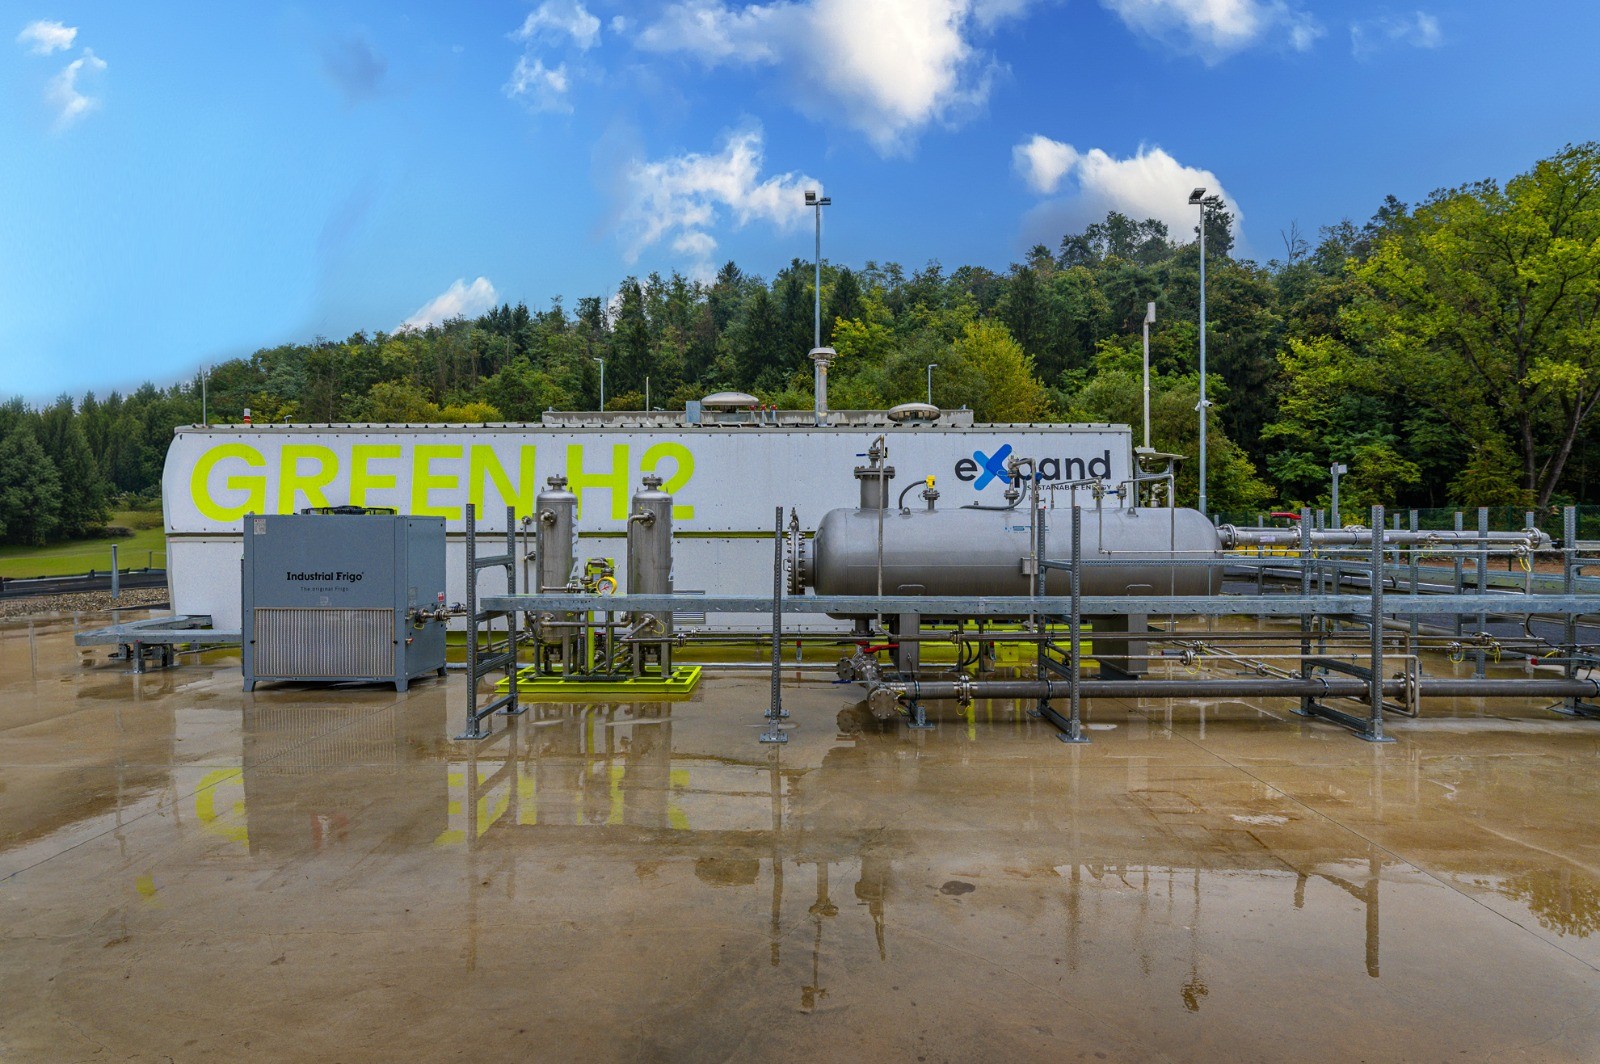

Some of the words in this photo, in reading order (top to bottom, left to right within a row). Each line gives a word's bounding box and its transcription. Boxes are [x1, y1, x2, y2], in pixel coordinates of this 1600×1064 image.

[190, 442, 536, 522] GREEN
[566, 441, 695, 521] H2
[286, 571, 334, 581] Industrial
[335, 571, 363, 583] Frigo
